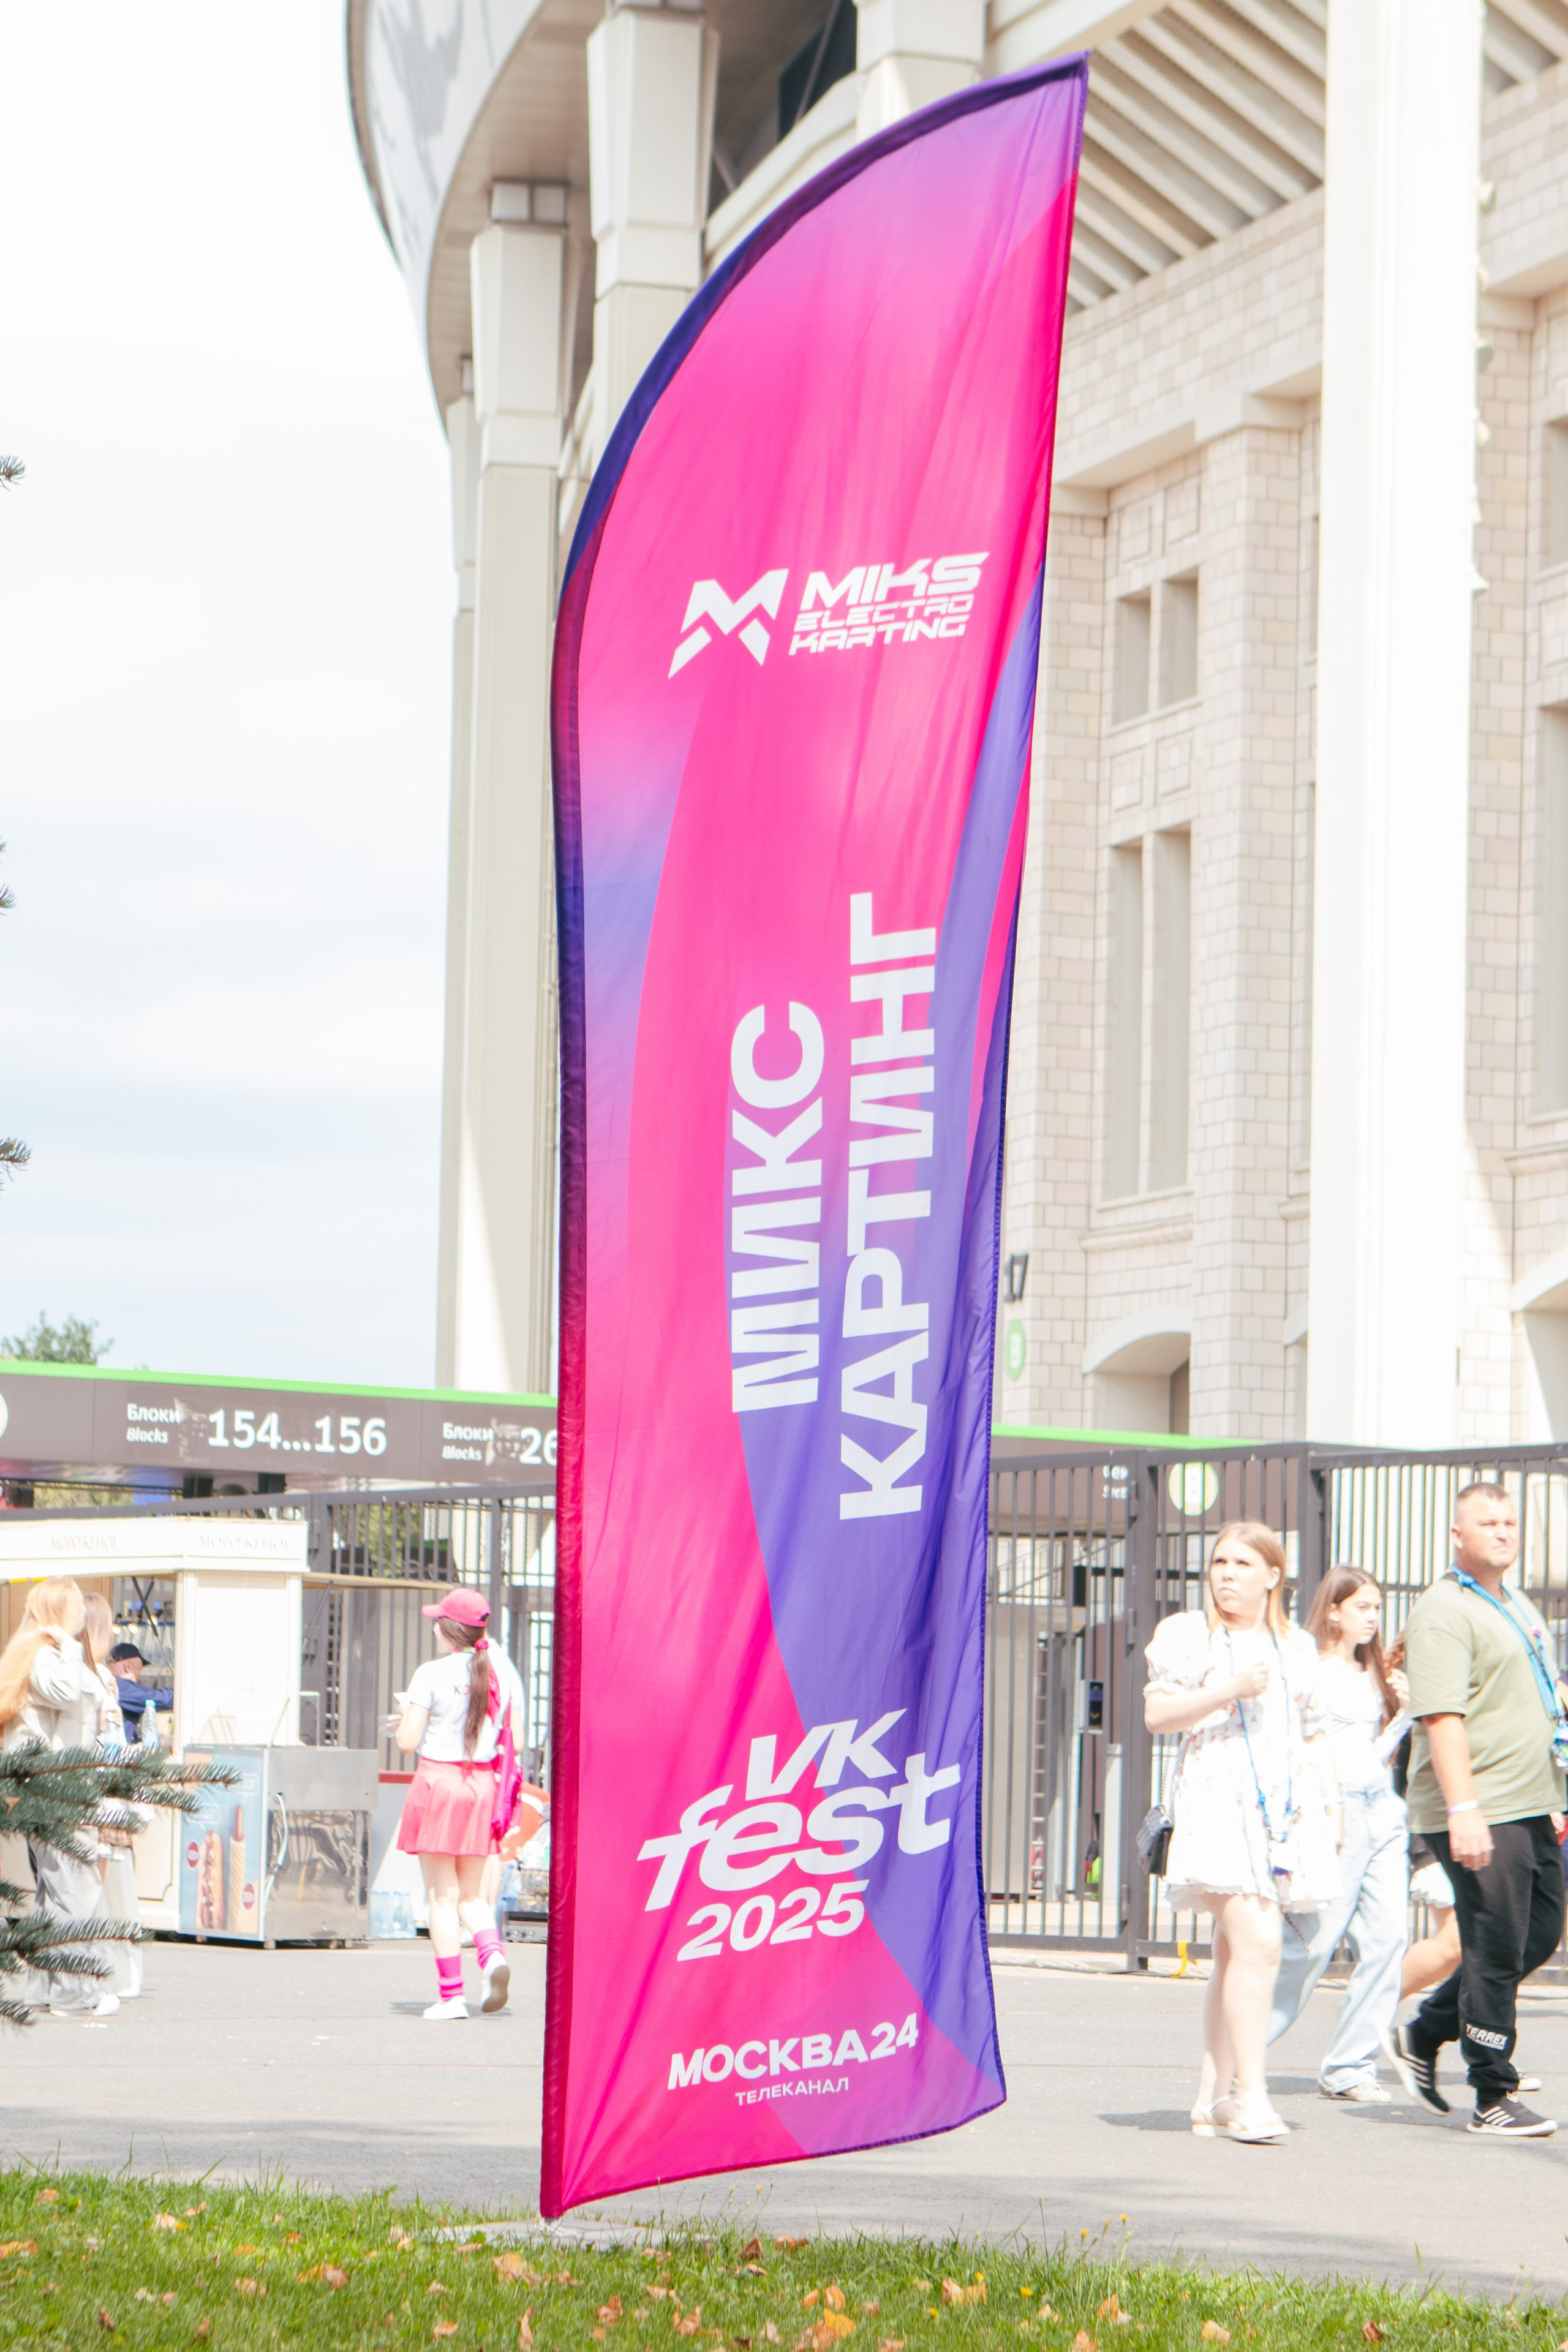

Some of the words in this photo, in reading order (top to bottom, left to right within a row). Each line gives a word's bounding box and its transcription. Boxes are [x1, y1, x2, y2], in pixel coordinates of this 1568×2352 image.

[799, 552, 989, 611] MIKS
[794, 594, 974, 632] ELECTRO
[788, 614, 970, 655] KARTING
[731, 1001, 824, 1413] МИКС
[840, 892, 937, 1520] КАРТИНГ
[127, 1403, 182, 1424] Блоки
[443, 1422, 495, 1442] Блоки
[126, 1427, 169, 1444] Blocks
[442, 1445, 483, 1461] Blocks
[745, 1708, 907, 1801] VK
[636, 1752, 961, 1912] fest
[677, 1879, 870, 1962] 2025
[1466, 2023, 1509, 2047] TERREX
[735, 2077, 850, 2106] ТЕЛЕКАНАЛ
